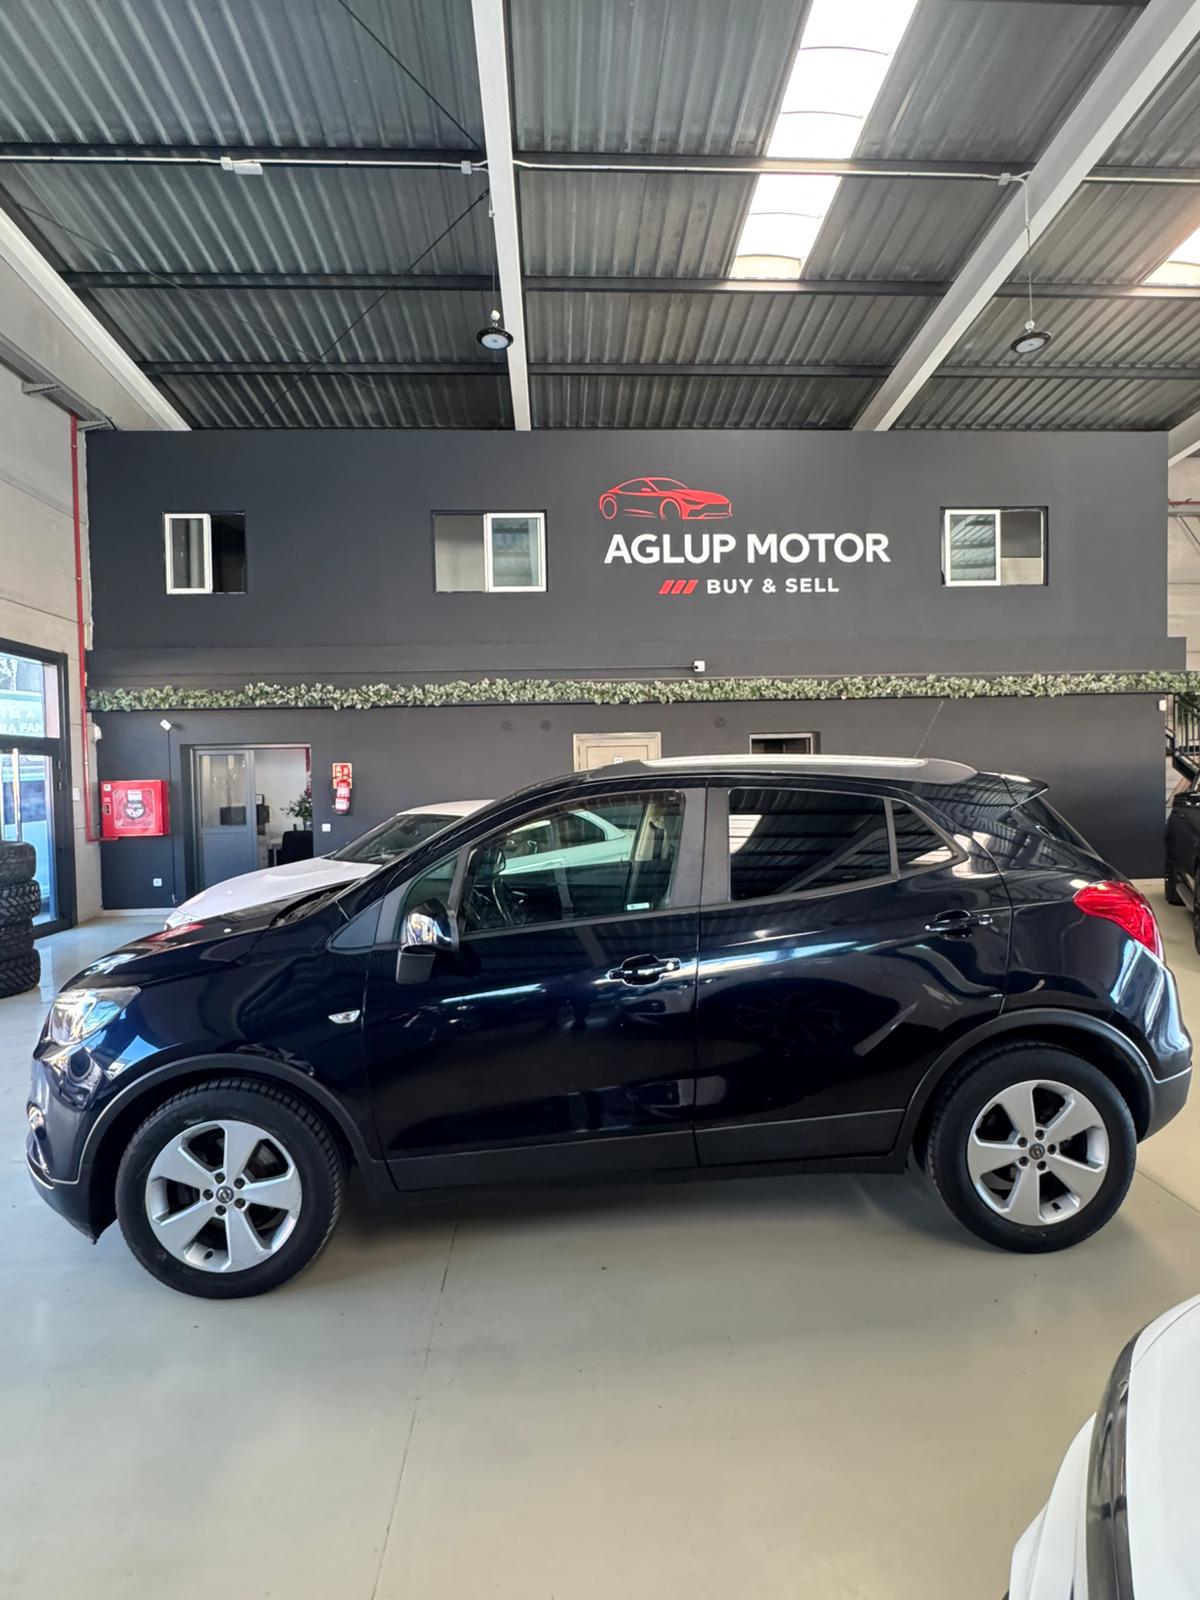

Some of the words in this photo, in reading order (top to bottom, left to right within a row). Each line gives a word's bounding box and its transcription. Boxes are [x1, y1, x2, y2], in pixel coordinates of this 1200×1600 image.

[603, 533, 737, 564] AGLUP
[746, 532, 892, 563] MOTOR
[706, 578, 753, 594] BUY
[761, 578, 777, 594] &
[785, 577, 840, 593] SELL
